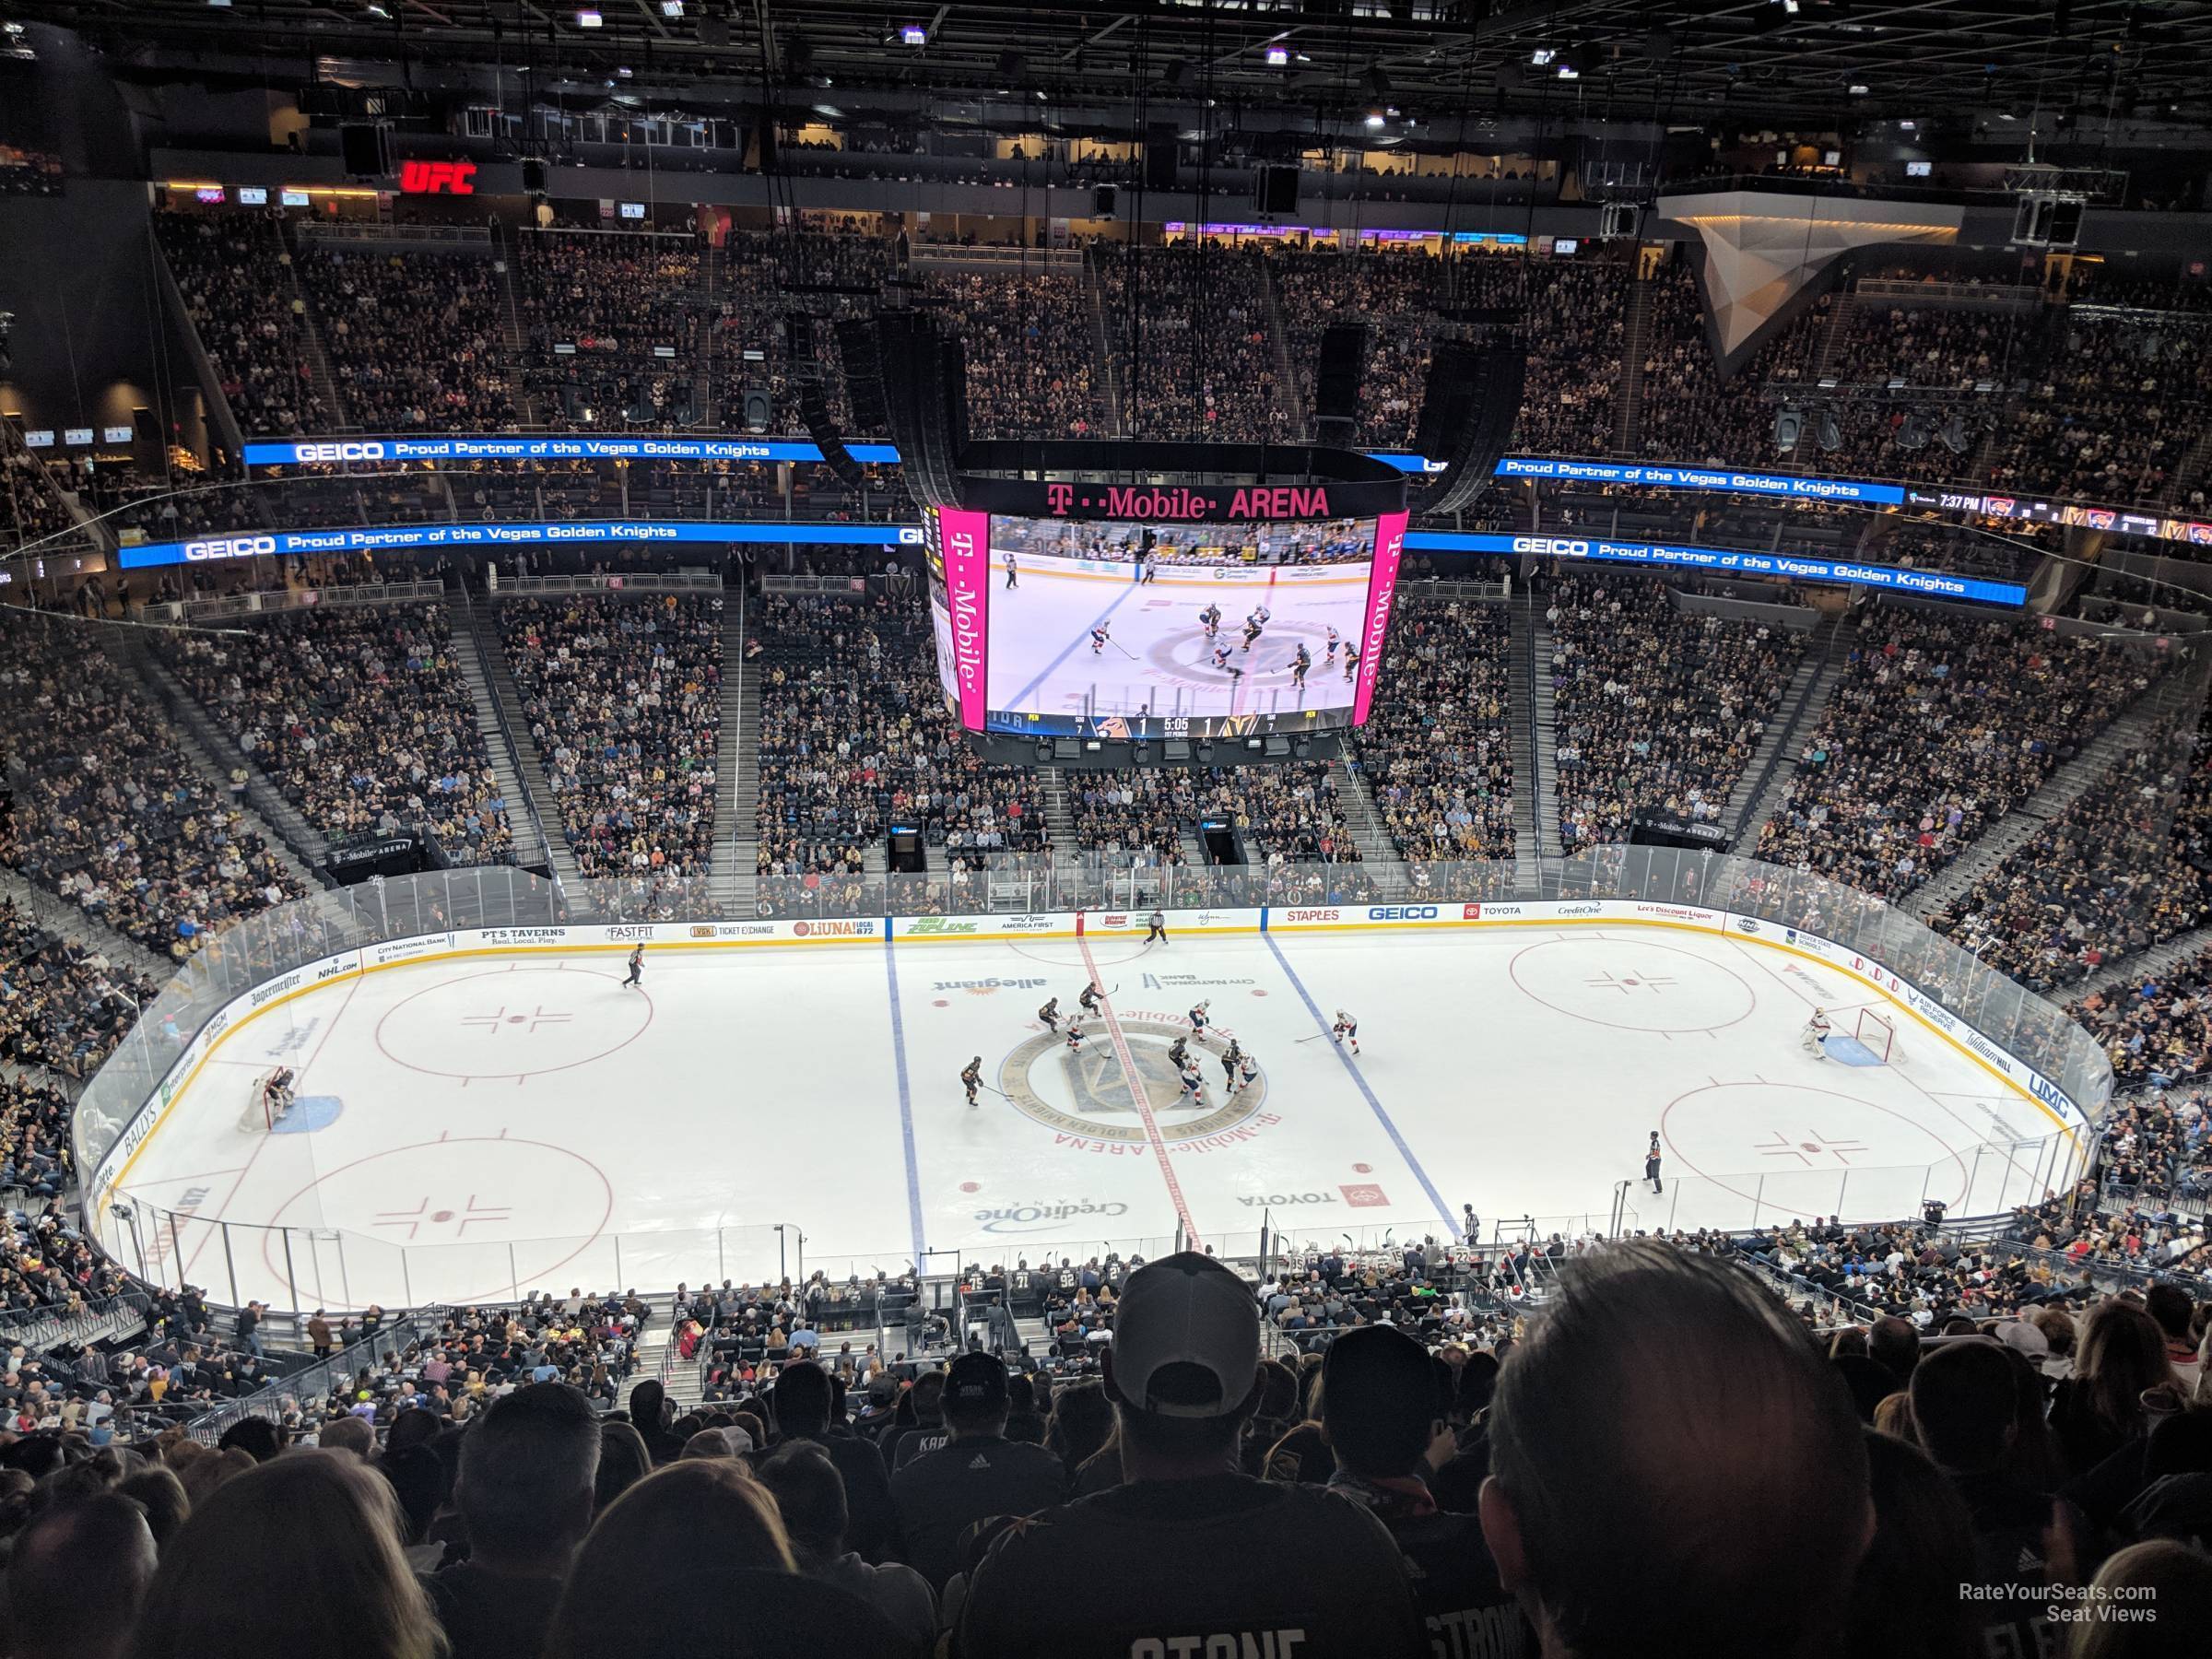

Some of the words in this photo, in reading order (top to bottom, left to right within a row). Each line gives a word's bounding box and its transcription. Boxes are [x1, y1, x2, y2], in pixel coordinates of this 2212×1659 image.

[400, 161, 477, 194] UFC
[295, 442, 384, 461] GEICO
[394, 443, 450, 455] Proud
[455, 442, 524, 454] Partner
[530, 442, 549, 453] of
[553, 442, 582, 453] the
[586, 442, 638, 455] Vegas
[643, 442, 700, 454] Golden
[705, 444, 770, 458] Knights
[1506, 461, 1554, 474] Proud
[1559, 464, 1620, 478] Partner
[1625, 467, 1642, 479] of
[1646, 471, 1673, 482] the
[1677, 472, 1727, 486] Vegas
[1732, 475, 1788, 490] Golden
[1793, 480, 1861, 497] Knights
[1229, 488, 1330, 519] ARENA
[1940, 494, 1961, 508] 7:37
[1962, 496, 1980, 511] PM
[185, 536, 276, 560] GEICO
[288, 535, 345, 548] Proud
[351, 532, 423, 546] Partner
[429, 529, 447, 541] of
[452, 528, 481, 540] the
[487, 527, 541, 540] Vegas
[547, 526, 606, 538] Golden
[610, 526, 677, 539] Knights
[1512, 537, 1589, 557] GEICO
[1598, 544, 1648, 558] Proud
[1653, 547, 1716, 563] Partner
[1721, 555, 1739, 566] of
[1742, 558, 1771, 570] the
[1777, 559, 1828, 575] Vegas
[1834, 565, 1891, 582] Golden
[1896, 573, 1965, 594] Knights
[1077, 725, 1083, 735] 7
[1139, 718, 1147, 735] 1
[1164, 718, 1189, 731] 5:05
[1204, 718, 1211, 735] 1
[1268, 723, 1274, 732] 7
[1686, 828, 1713, 838] ARENA
[379, 843, 406, 855] ARENA
[1287, 910, 1339, 922] STAPLES
[1369, 906, 1438, 920] GEICO
[1484, 907, 1521, 915] TOYOTA
[1656, 906, 1687, 915] Discount
[1688, 911, 1713, 920] Liquor
[481, 929, 507, 938] PT'S
[511, 928, 566, 937] TAVERNS
[719, 926, 740, 935] TICKET
[513, 936, 536, 945] Local.
[538, 936, 557, 945] Play.
[1799, 933, 1818, 944] SILVER
[1818, 940, 1831, 948] STATE
[932, 977, 1048, 990] allegiant
[1919, 998, 1932, 1010] AIR
[1932, 1004, 1956, 1028] FORCE
[1920, 1006, 1953, 1032] RESERVE
[211, 1012, 228, 1032] MGM
[2029, 1074, 2069, 1119] UMC
[1053, 1133, 1145, 1156] ARENA
[1238, 1192, 1336, 1207] TOYOTA
[969, 1277, 983, 1290] 75
[1017, 1276, 1029, 1288] 71
[1060, 1273, 1075, 1288] 92
